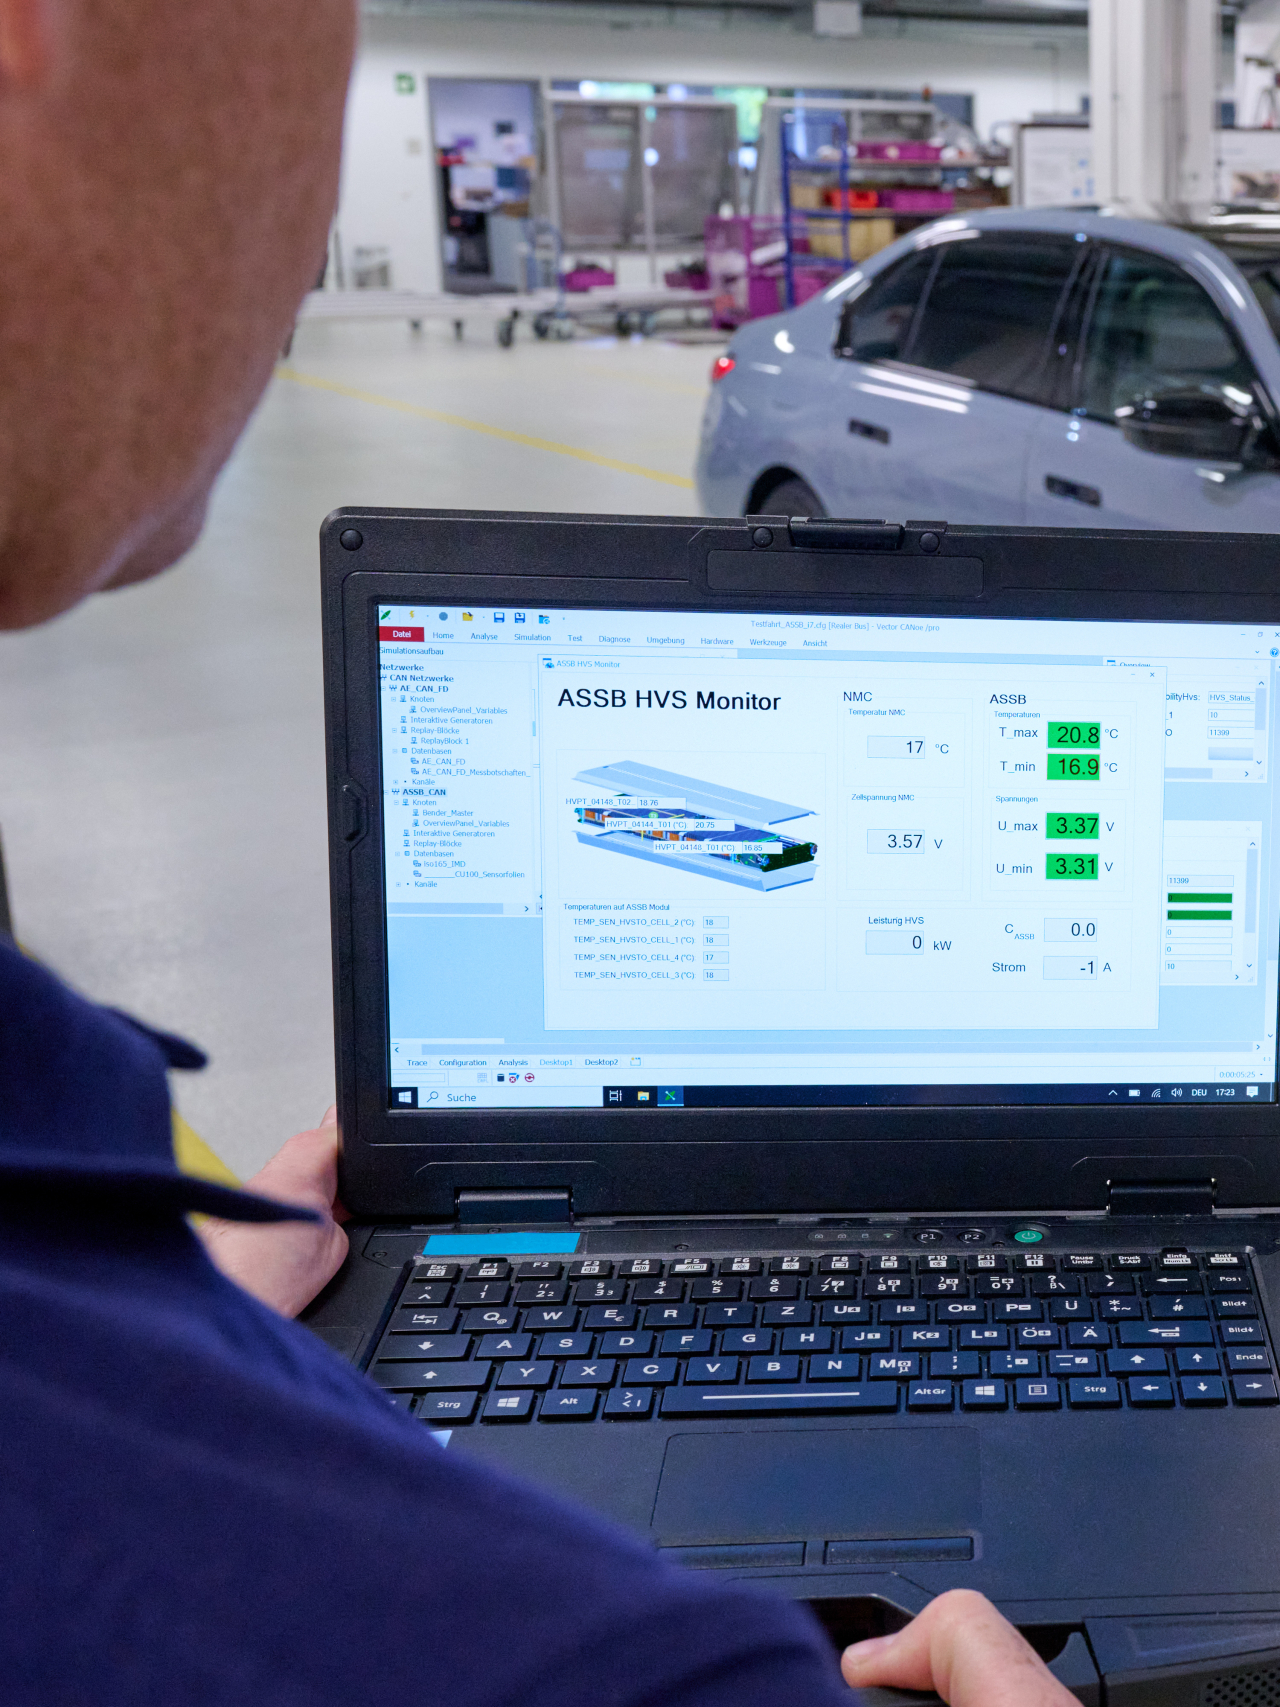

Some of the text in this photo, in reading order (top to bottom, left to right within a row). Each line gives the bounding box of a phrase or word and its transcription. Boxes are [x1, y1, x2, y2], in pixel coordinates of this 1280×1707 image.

[392, 630, 412, 638] Datei
[471, 633, 498, 641] Analyse
[514, 633, 552, 642] Simulation
[599, 635, 631, 644] Diagnose
[647, 636, 685, 645] Umgebung
[700, 637, 734, 645] Hardware
[750, 638, 787, 647] Werkzeuge
[803, 639, 828, 647] Ansicht
[379, 647, 444, 655] Simulationsaufbau
[577, 660, 593, 668] HVS
[595, 660, 620, 668] Monitor
[389, 674, 454, 682] CAN Netzwerke
[400, 684, 449, 693] AE_CAN_FD
[410, 695, 434, 703] Knoten
[557, 688, 781, 710] ASSB HVS Monitor
[843, 691, 873, 702] NMC
[989, 693, 1027, 705] ASSB
[420, 706, 508, 714] OverviewPanel_Variables
[849, 708, 906, 717] Temperatur NMC
[994, 710, 1041, 719] Temperaturen
[410, 716, 493, 725] Interaktive Generatoren
[410, 726, 460, 735] Replay-Blöcke
[999, 726, 1119, 744] T_max 20.8 °C
[421, 736, 463, 746] ReplayBlock
[411, 747, 452, 755] Datenbasen
[906, 740, 949, 754] 17 °C
[421, 757, 466, 766] AE_CAN_FD
[1000, 758, 1118, 775] T_min 16.9 °C
[412, 778, 435, 786] Kanäle
[402, 788, 446, 797] ASSB_CAN
[851, 793, 897, 803] Zellspannung
[995, 795, 1039, 804] Spannungen
[422, 809, 474, 818] Bender_Master
[423, 820, 510, 828] OverviewPanel_Variables
[695, 821, 715, 829] 20.75
[998, 816, 1115, 834] U_max 3.37 V
[413, 830, 495, 838] Interaktive Generatoren
[413, 840, 462, 848] Replay-Blöcke
[887, 834, 943, 849] 3.57 V
[743, 844, 763, 852] 16.85
[413, 850, 454, 858] Datenbasen
[423, 860, 466, 869] iso165_IMD
[996, 858, 1114, 875] U_min 3.31 V
[414, 880, 437, 888] Kanäle
[563, 903, 670, 912] Temperaturen auf ASSB Modul
[868, 916, 925, 927] Leistung HVS
[1004, 923, 1014, 934] C
[1071, 922, 1096, 937] 0.0
[705, 936, 714, 944] 18
[912, 935, 952, 951] 0 kW
[705, 953, 714, 961] 17
[992, 960, 1112, 974] Strom -1 A
[705, 971, 714, 979] 18
[439, 1059, 487, 1068] Configuration
[498, 1059, 529, 1068] Analysis
[539, 1058, 574, 1068] Desktop1
[584, 1058, 619, 1068] Desktop2
[447, 1088, 1235, 1102] Suche DEU 17:23
[603, 1309, 618, 1318] E
[663, 1309, 678, 1318] R
[724, 1307, 737, 1317] T
[781, 1306, 795, 1315] Z
[483, 1312, 500, 1322] Q
[543, 1311, 563, 1320] W
[619, 1337, 635, 1346] D
[681, 1335, 694, 1345] F
[742, 1334, 756, 1343] G
[800, 1333, 815, 1342] H
[496, 1339, 512, 1349] A
[559, 1339, 573, 1348] S
[1236, 1353, 1263, 1361] Ende
[520, 1367, 535, 1377] Y
[1085, 1385, 1106, 1394] Strg
[437, 1401, 461, 1409] Strg
[560, 1397, 578, 1405] Alt
